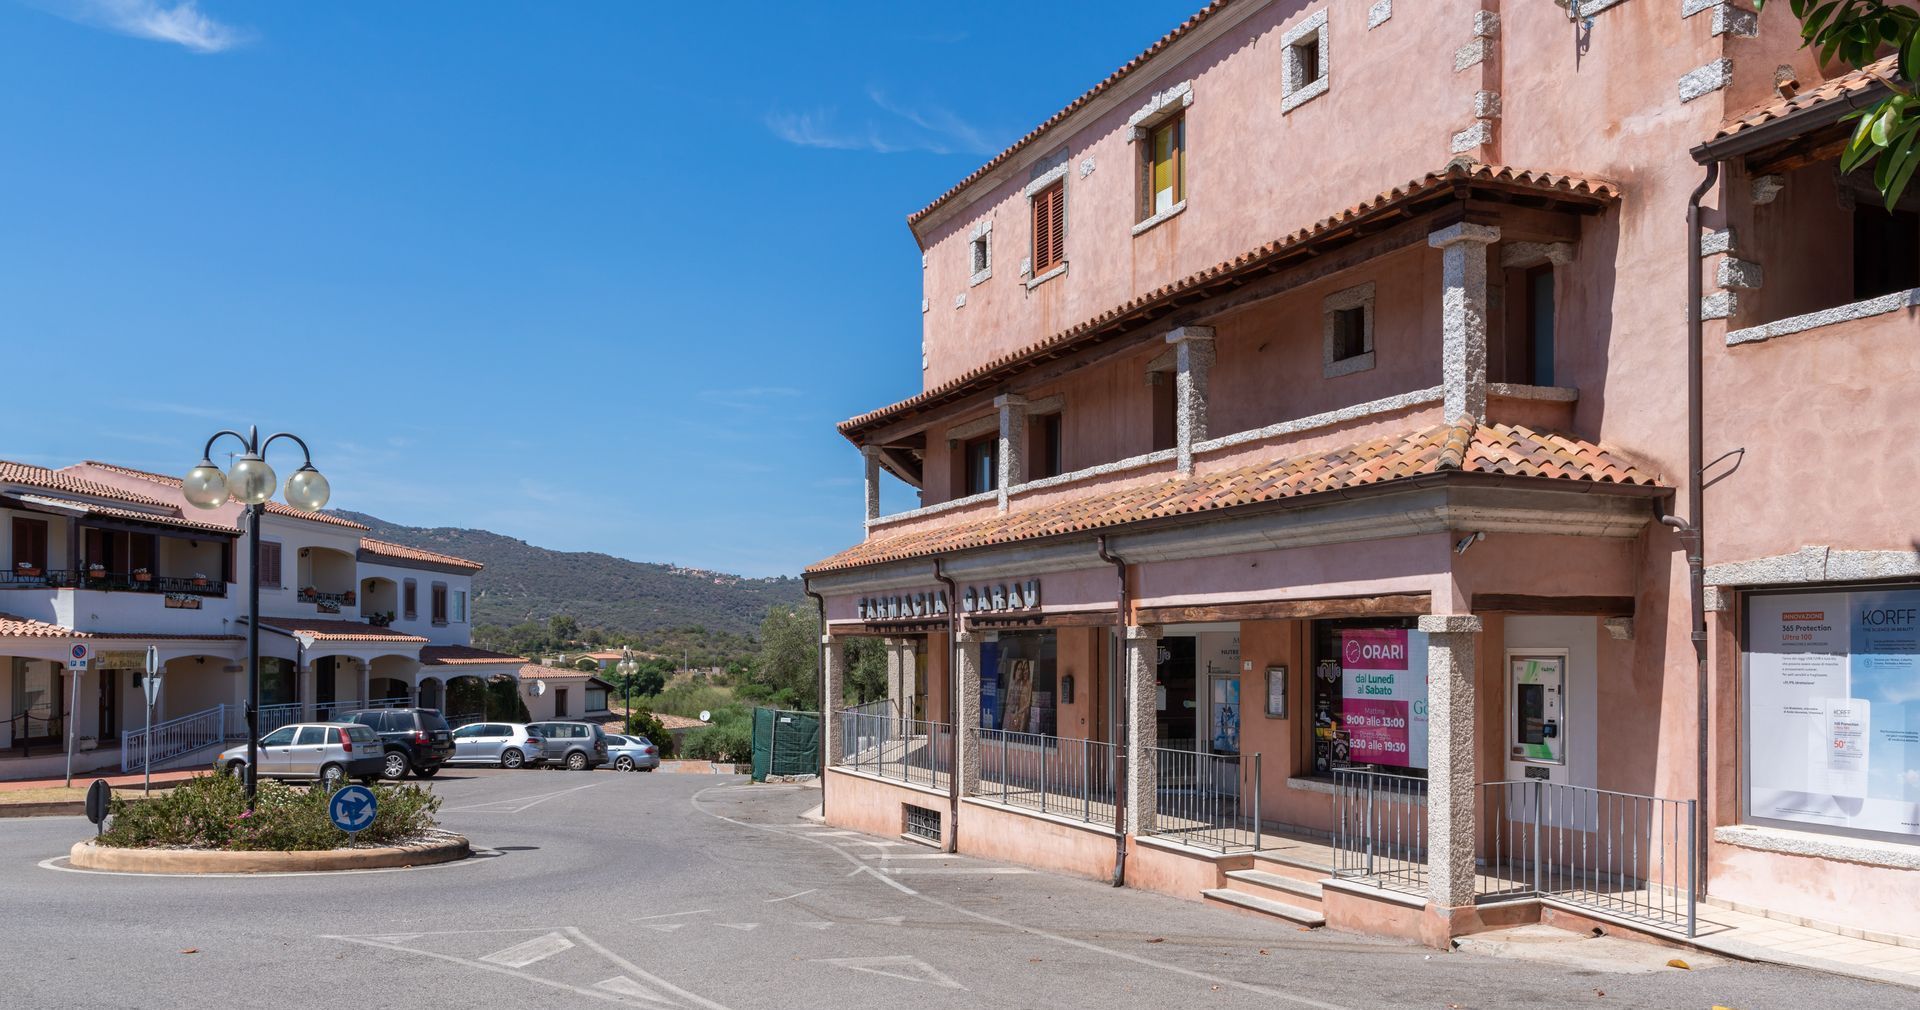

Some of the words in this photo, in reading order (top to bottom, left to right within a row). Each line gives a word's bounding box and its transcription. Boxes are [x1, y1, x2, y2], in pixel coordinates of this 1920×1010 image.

[857, 589, 948, 619] FARMACIA
[962, 578, 1041, 613] GARAU
[1783, 612, 1824, 620] INNOVAZIONE
[1862, 608, 1917, 625] KORFF
[1362, 644, 1404, 660] ORARI
[1355, 674, 1367, 683] dal
[1357, 685, 1364, 694] al
[1365, 685, 1392, 696] Sabato
[1346, 714, 1365, 725] 9:00
[1366, 715, 1381, 727] alle
[1382, 717, 1405, 728] 13:00
[1367, 740, 1383, 750] alle
[1384, 741, 1406, 753] 19:30
